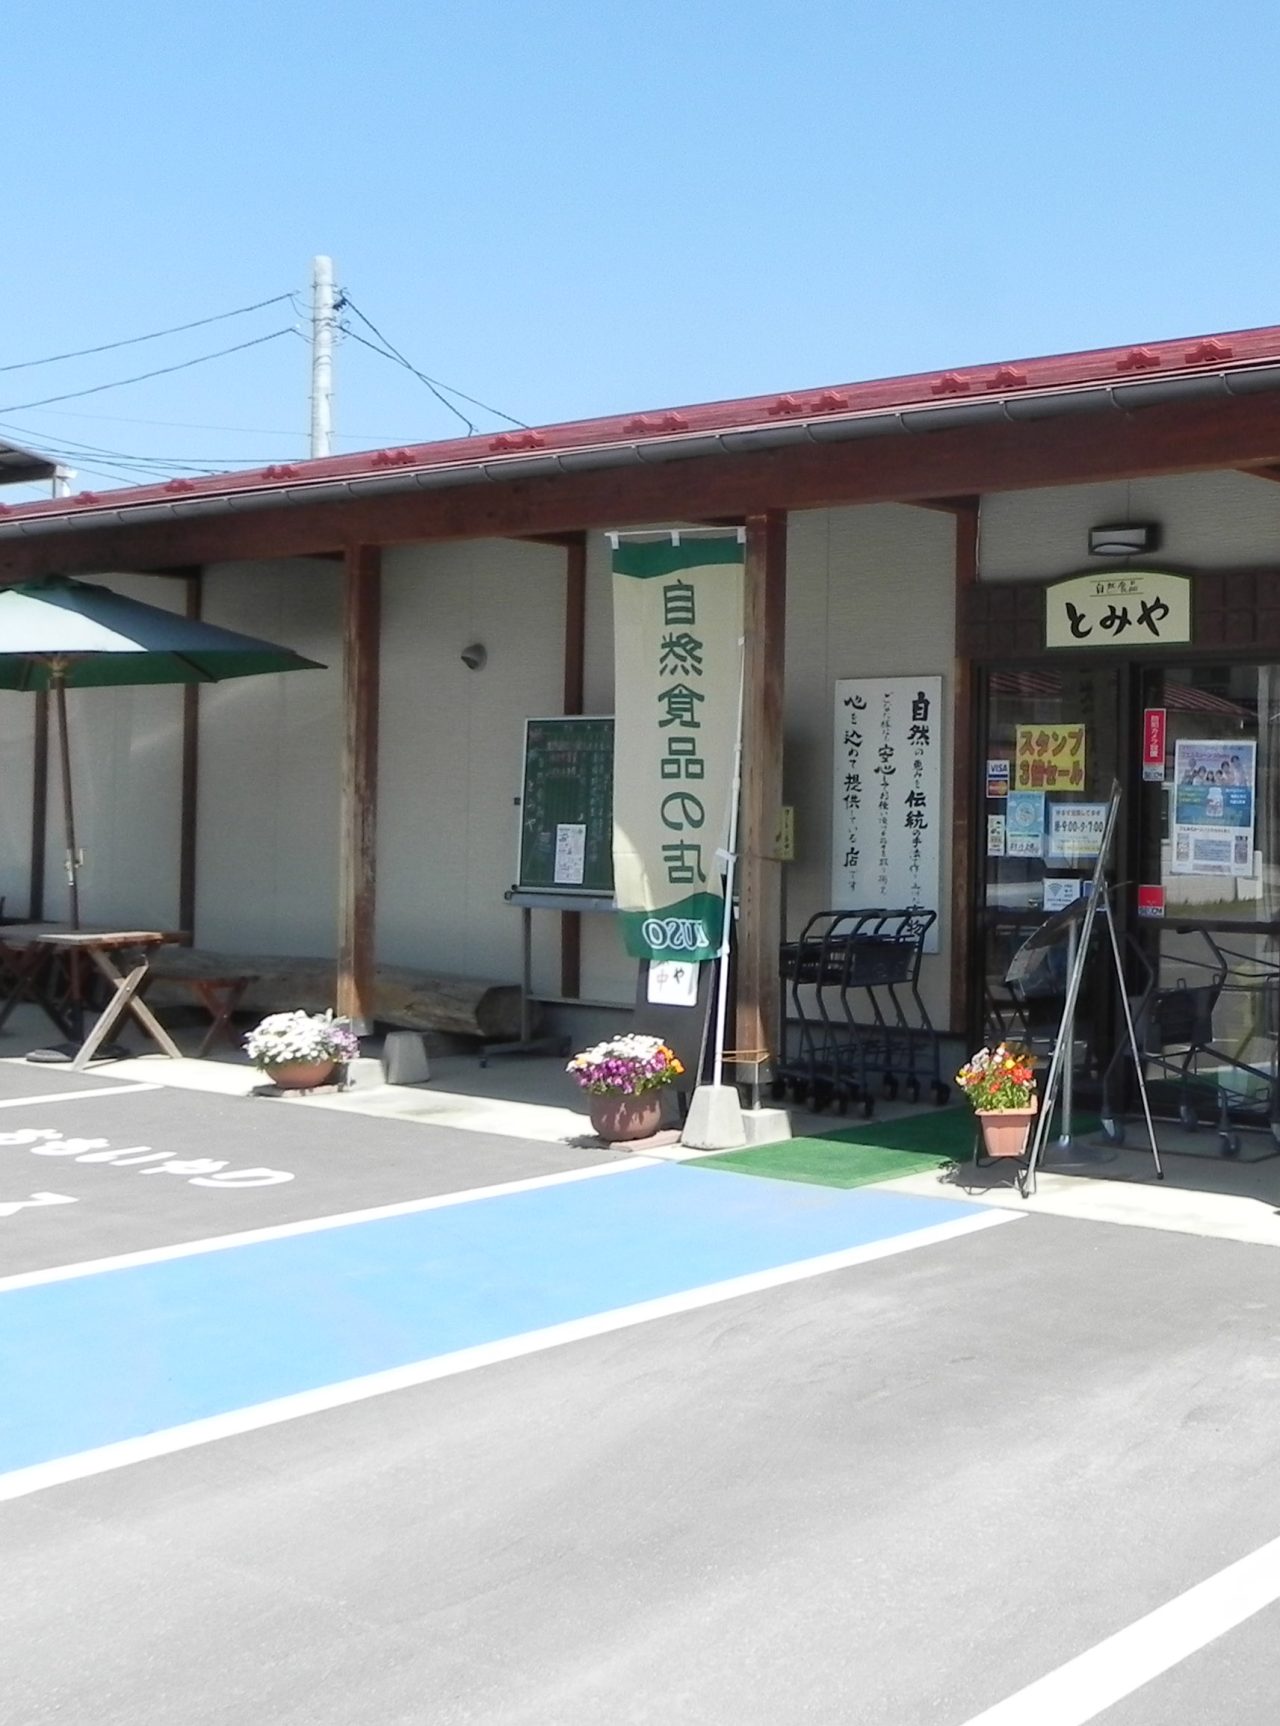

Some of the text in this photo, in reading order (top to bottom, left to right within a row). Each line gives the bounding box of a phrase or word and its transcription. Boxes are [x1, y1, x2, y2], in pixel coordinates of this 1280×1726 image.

[1065, 596, 1170, 639] とみや
[1020, 728, 1083, 757] スタンプ
[991, 763, 1008, 773] VISA
